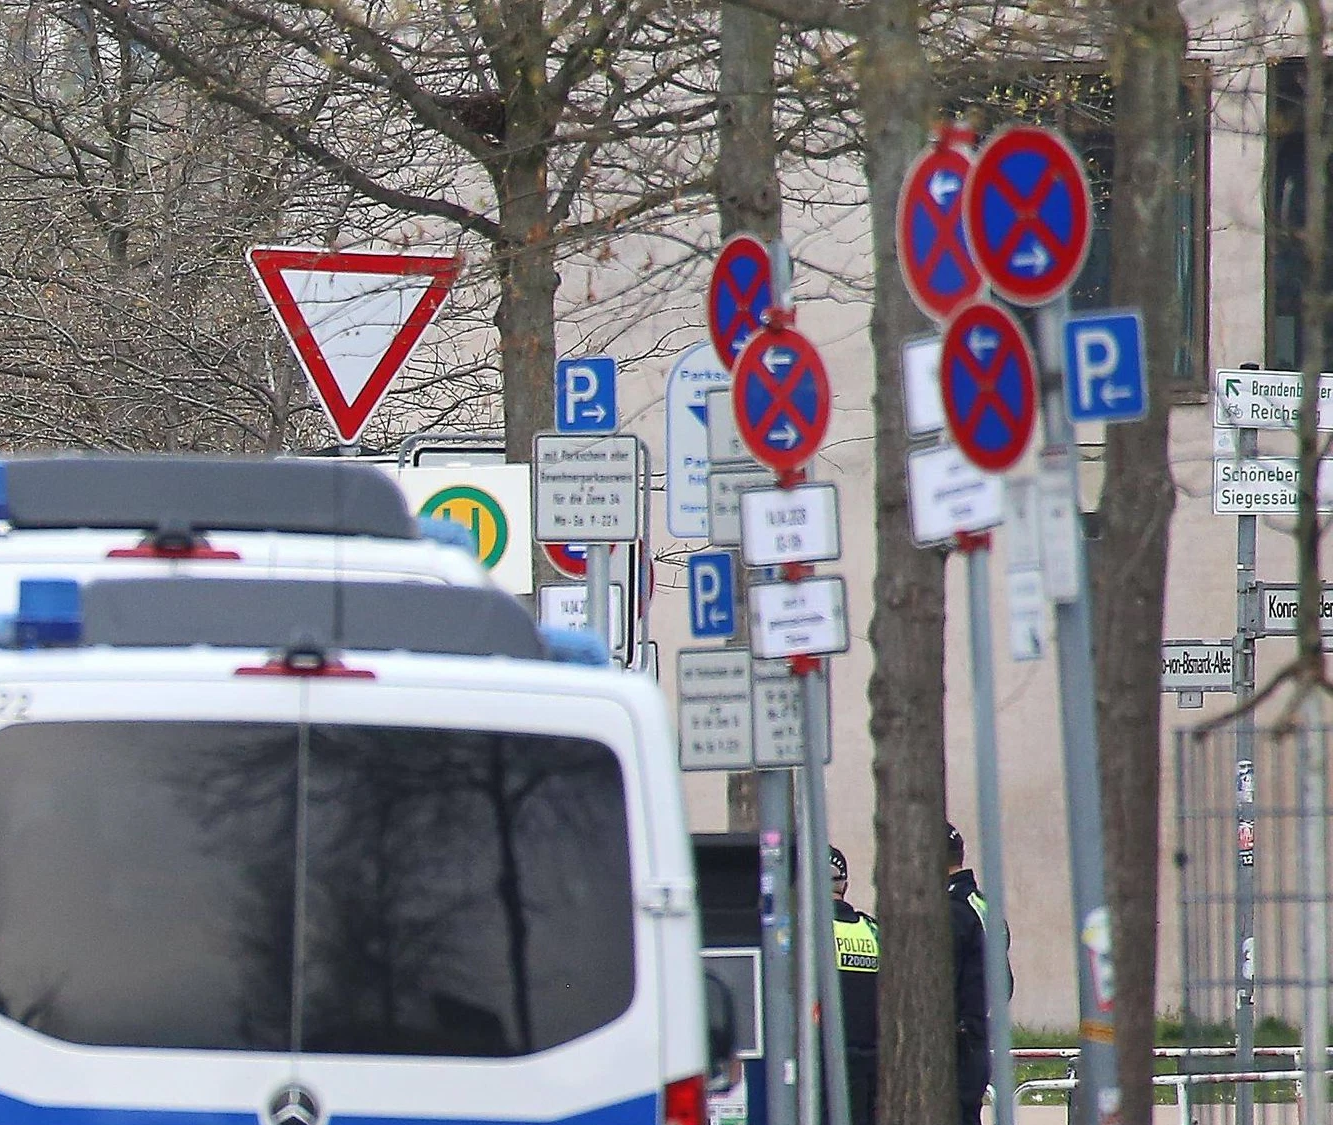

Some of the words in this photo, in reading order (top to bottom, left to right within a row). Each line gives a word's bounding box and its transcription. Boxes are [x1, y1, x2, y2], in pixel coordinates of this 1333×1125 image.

[1074, 327, 1120, 410] P
[565, 366, 598, 425] P
[1252, 380, 1331, 398] Brandenber
[1222, 466, 1299, 483] Schöneber
[1221, 489, 1298, 508] Siegessäu
[693, 562, 721, 630] P
[836, 937, 875, 953] POLIZEI
